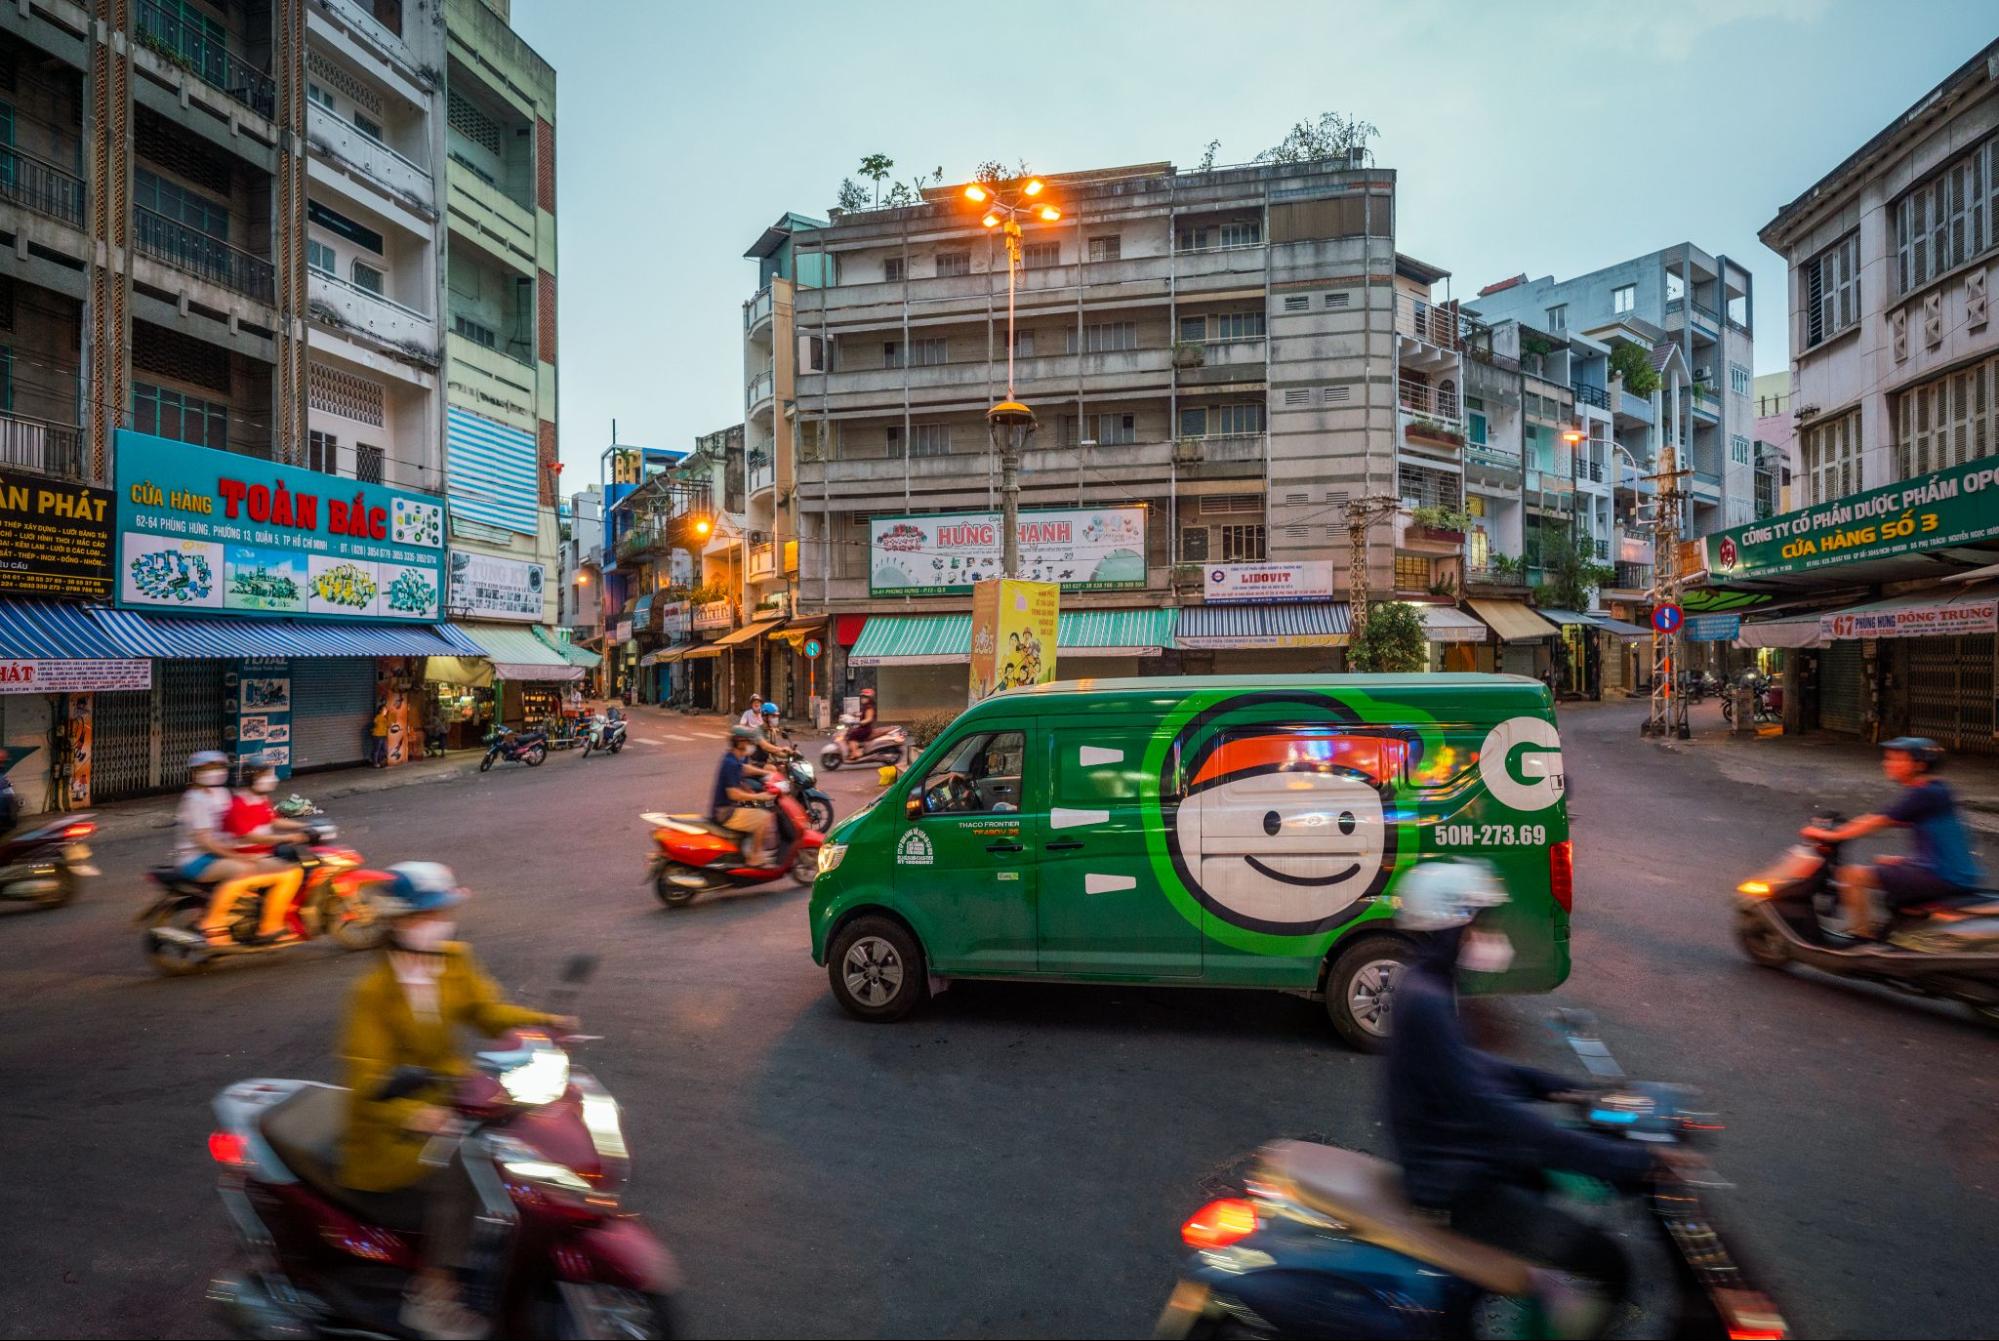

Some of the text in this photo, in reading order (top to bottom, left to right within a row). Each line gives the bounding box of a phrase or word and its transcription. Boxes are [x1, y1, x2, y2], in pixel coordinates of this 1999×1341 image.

[38, 490, 107, 522] PHÁT
[131, 477, 387, 540] CỬA HÀNG TOÀN BẮC
[1742, 526, 1773, 546] CÔNG
[1773, 522, 1790, 538] TY
[1792, 510, 1811, 534] CỔ
[1813, 502, 1852, 530] PHẦN
[1855, 493, 1900, 518] DƯỢC
[1902, 475, 1959, 507] PHẨM
[136, 515, 157, 528] 62-64
[160, 517, 186, 533] PHÙNG
[256, 531, 273, 545] QUẬN
[937, 521, 994, 546] HƯNG
[1002, 521, 1072, 547] HẠNH
[1782, 537, 1817, 558] CỬA
[1821, 527, 1877, 552] HÀNG
[1881, 509, 1915, 540] SỐ
[1921, 513, 1939, 532] 3
[1833, 616, 1855, 636] 67
[984, 820, 1020, 828] FRONTIER
[1435, 825, 1546, 846] 50H-273.69
